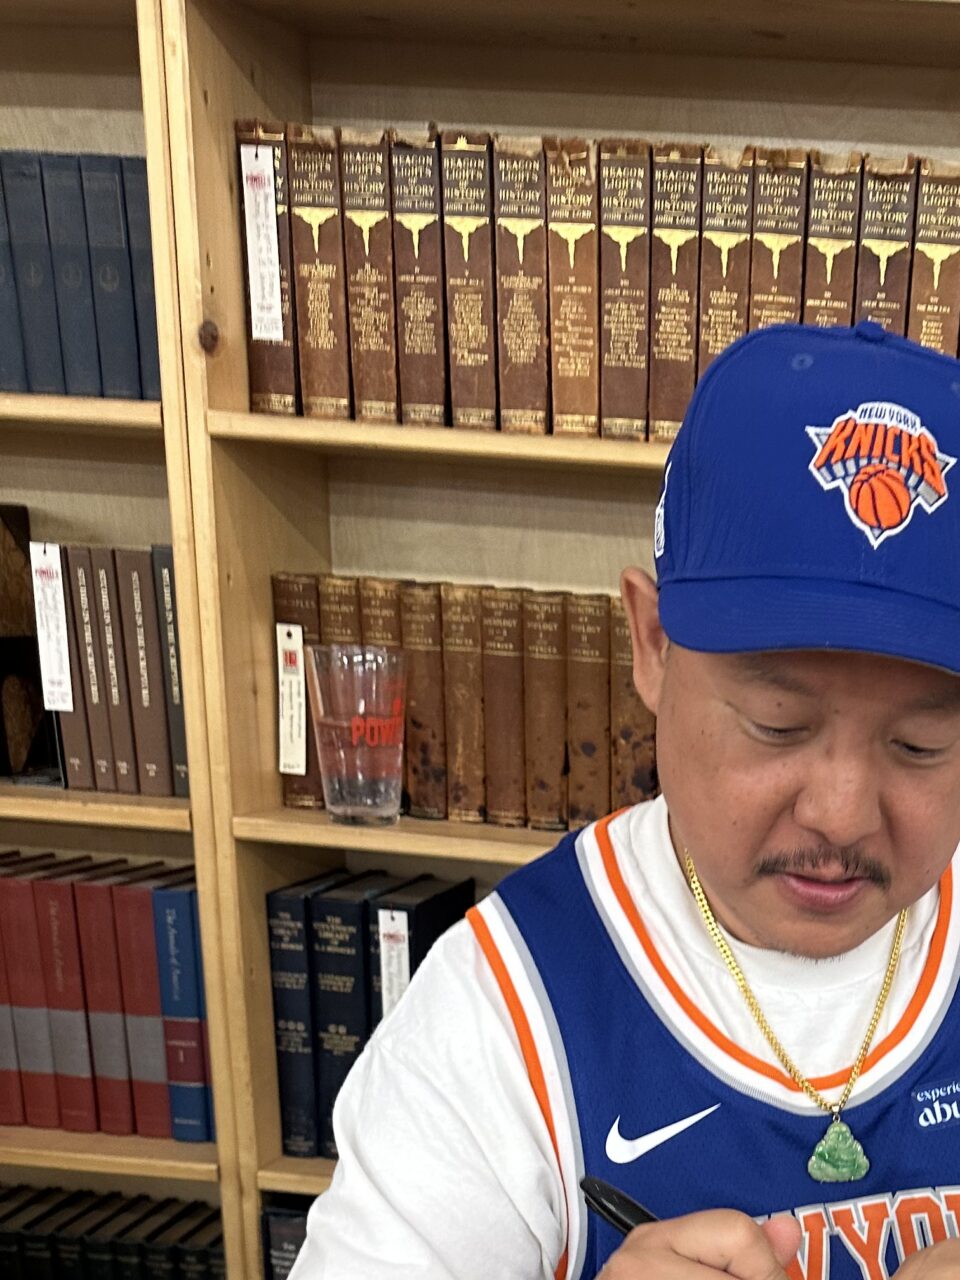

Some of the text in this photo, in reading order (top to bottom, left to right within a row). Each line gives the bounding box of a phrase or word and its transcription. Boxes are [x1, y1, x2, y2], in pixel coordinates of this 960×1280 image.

[602, 166, 644, 178] BEACON
[656, 170, 697, 182] BEACON
[707, 172, 748, 184] BEACON
[604, 178, 642, 190] LIGHTS
[758, 173, 800, 186] BEACON
[814, 178, 855, 190] BEACON
[868, 180, 910, 192] BEACON
[657, 181, 694, 194] LIGHTS
[708, 182, 746, 196] LIGHTS
[760, 185, 798, 198] LIGHTS
[602, 196, 645, 209] HISTORY
[815, 190, 853, 202] LIGHTS
[869, 192, 907, 204] LIGHTS
[654, 200, 697, 213] HISTORY
[706, 202, 748, 215] HISTORY
[757, 203, 800, 216] HISTORY
[812, 208, 854, 222] HISTORY
[865, 210, 908, 224] HISTORY
[858, 406, 918, 431] NEW YORK
[813, 417, 945, 496] KNICKS
